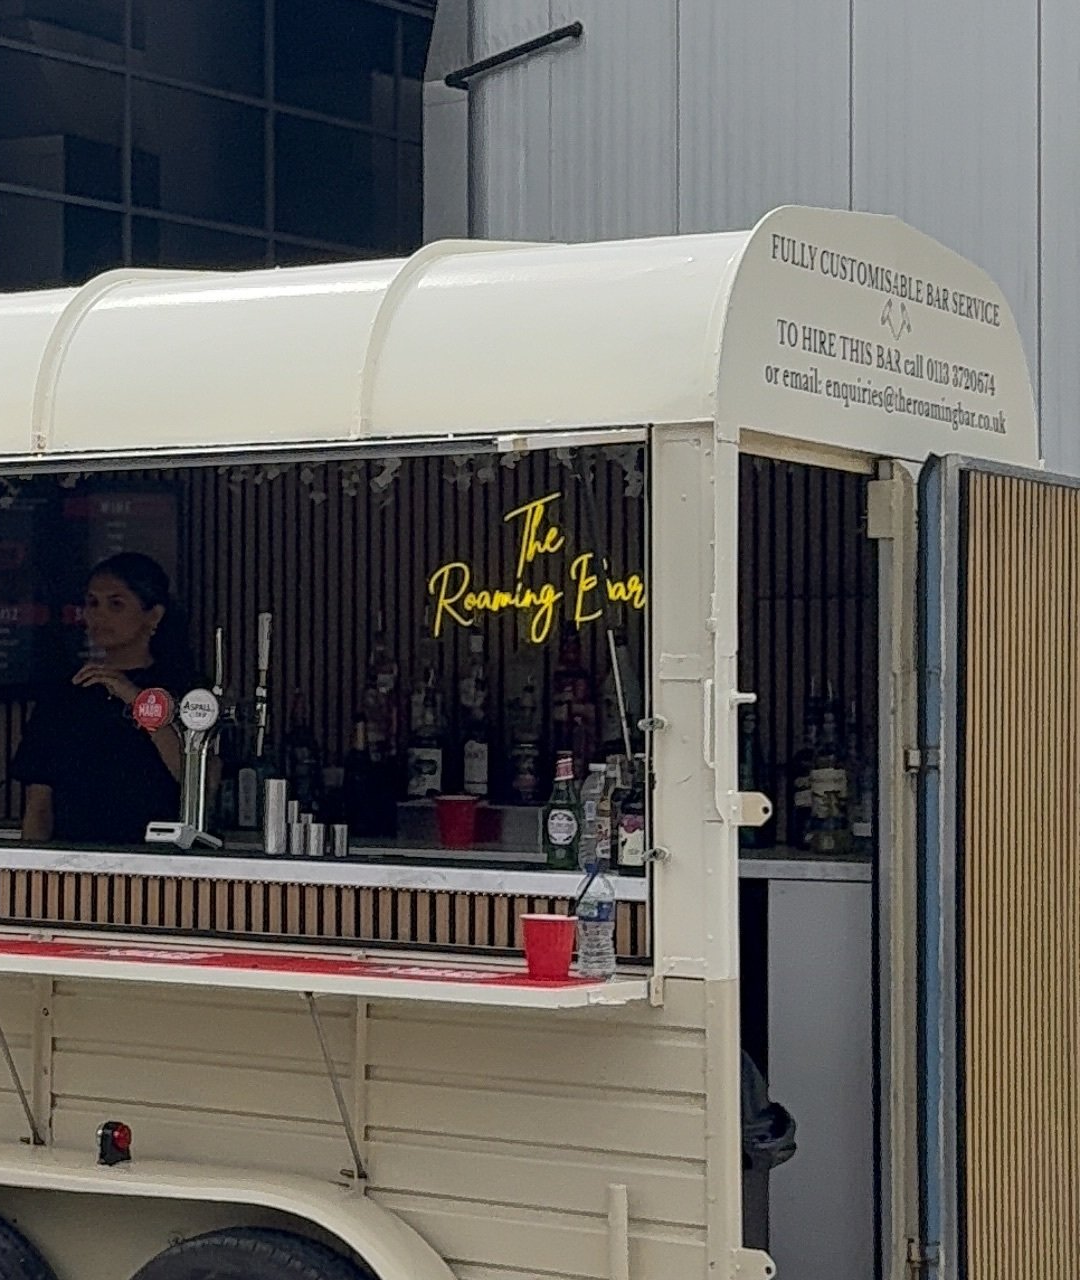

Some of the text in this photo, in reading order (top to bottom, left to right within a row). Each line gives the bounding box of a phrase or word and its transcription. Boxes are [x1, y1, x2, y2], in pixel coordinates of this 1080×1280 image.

[771, 233, 1001, 328] FULLY CUSTOMISABLE BAR SERVICE
[765, 365, 1007, 435] or email: enquiries@theroamingbar.co.uk
[776, 318, 996, 397] TO HIRE THIS BAR call 0113 3720674
[503, 491, 565, 579] The
[428, 552, 646, 644] Roaming Bar
